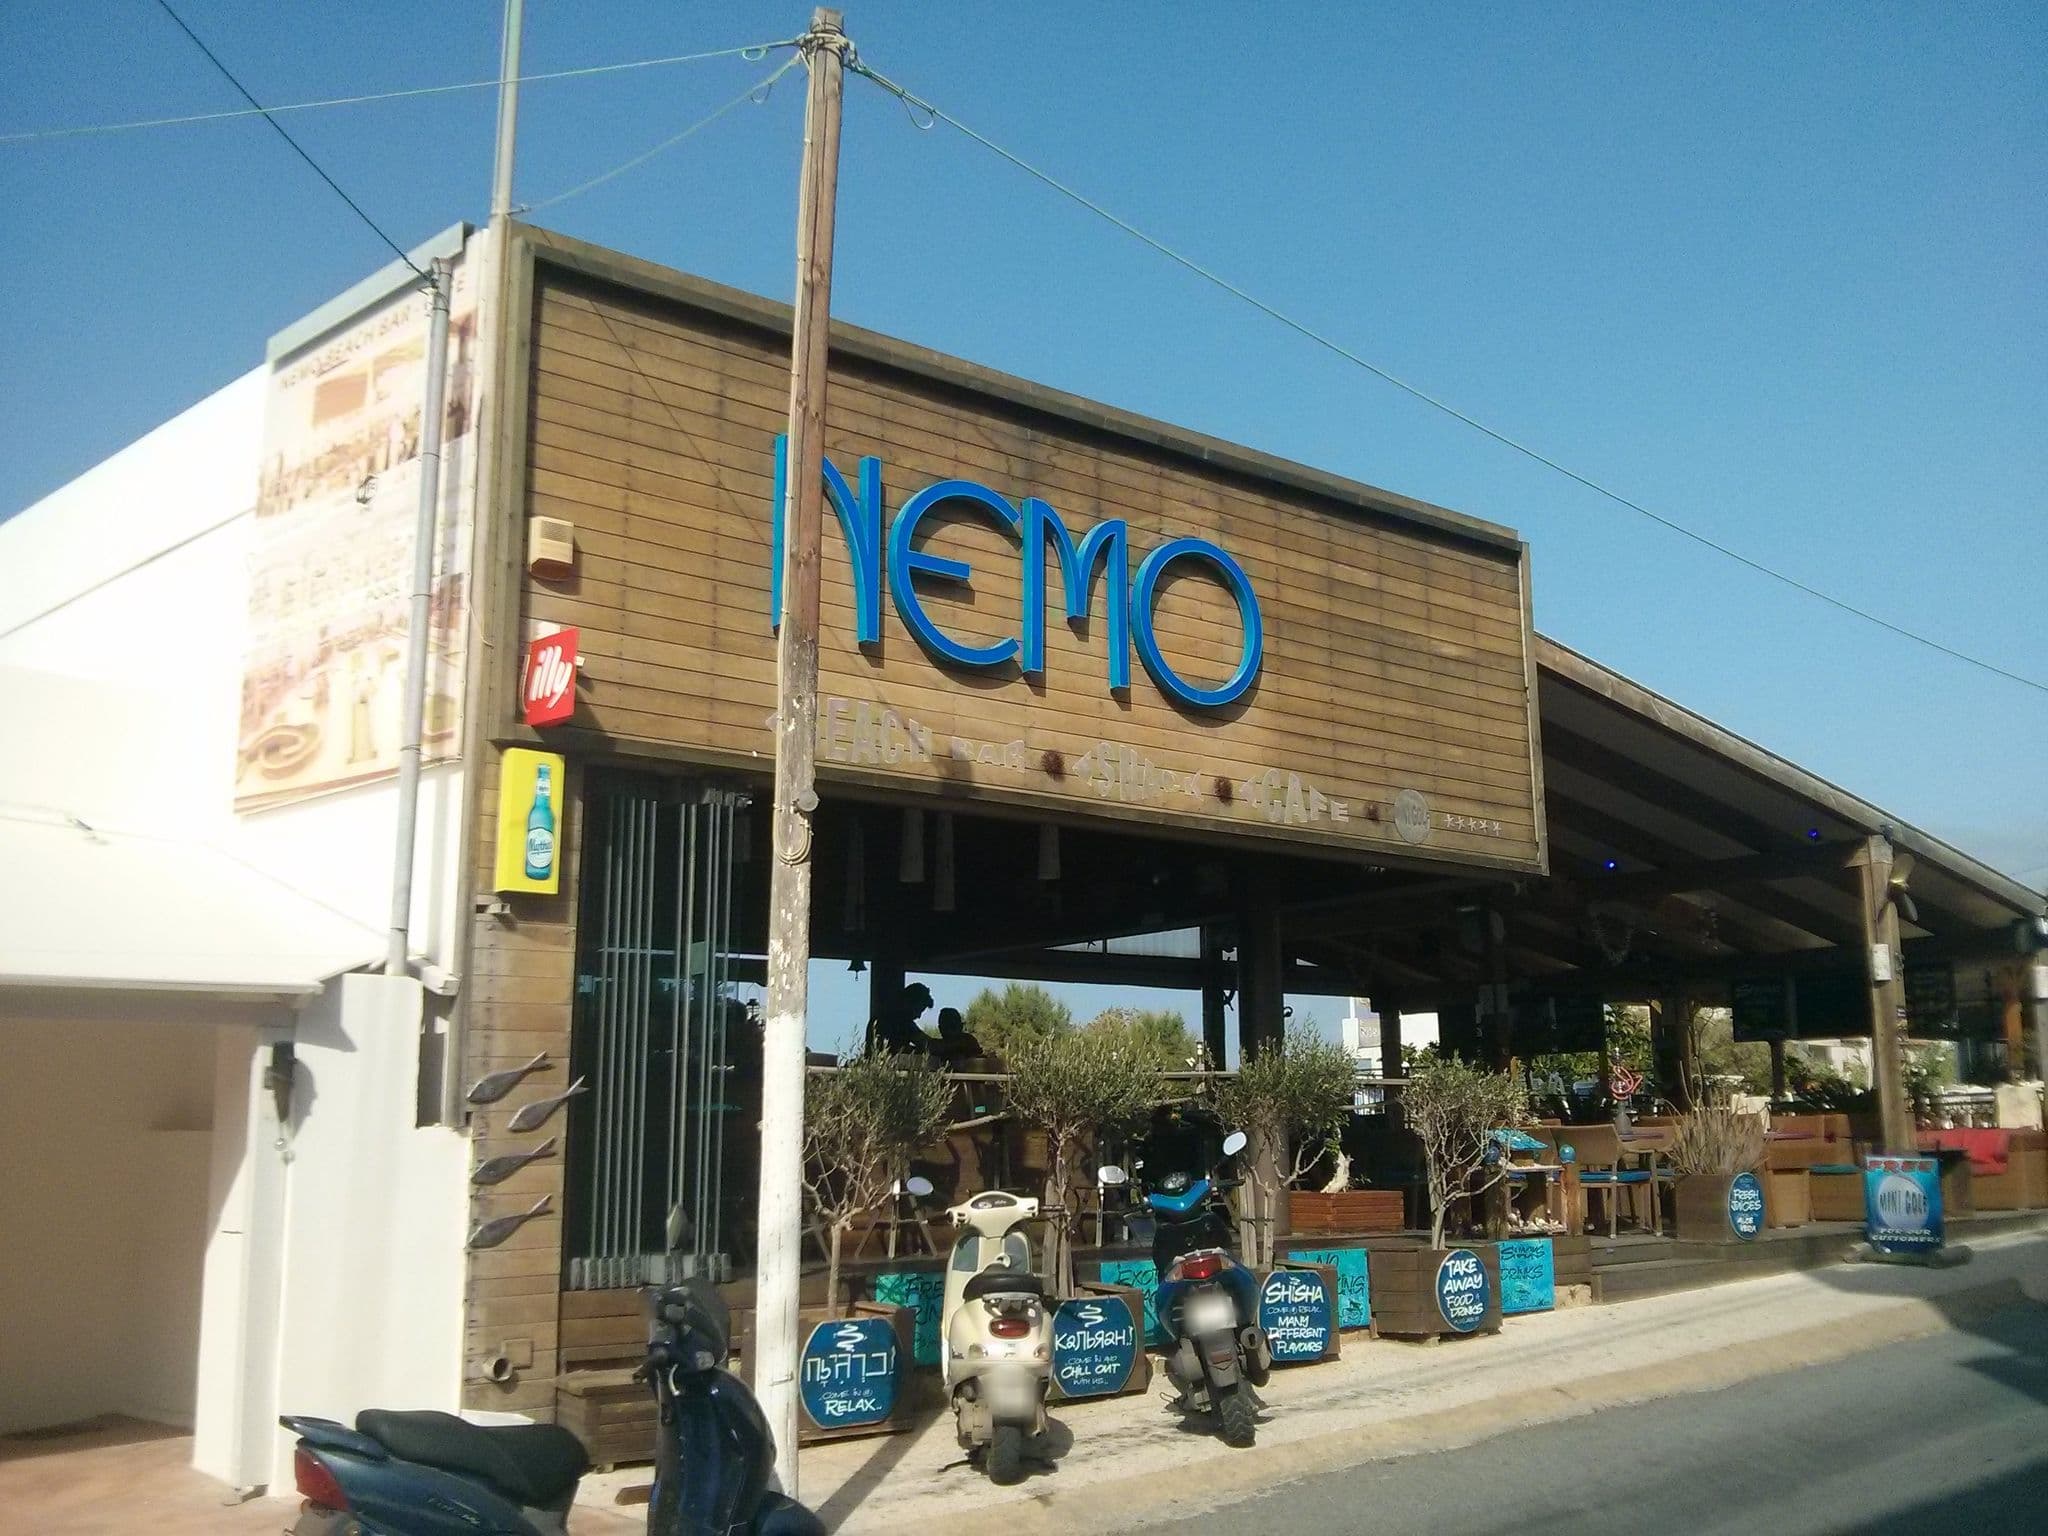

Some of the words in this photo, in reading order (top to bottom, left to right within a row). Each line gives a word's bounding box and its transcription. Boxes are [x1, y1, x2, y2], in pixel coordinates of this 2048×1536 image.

[380, 304, 411, 336] BAR
[773, 435, 1263, 706] NEMO
[529, 646, 573, 709] illy
[824, 697, 934, 765] EACH
[951, 736, 1027, 774] BAR
[1866, 1160, 1935, 1174] FREE
[1880, 1190, 1902, 1215] MINI
[1905, 1190, 1929, 1215] GOLF
[1871, 1234, 1942, 1243] CUSTOMERS
[1445, 1258, 1478, 1278] TAKE
[1443, 1273, 1483, 1294] AWAY
[1445, 1294, 1473, 1308] FOOD
[1450, 1303, 1484, 1317] DRINKS
[1278, 1315, 1309, 1328] MANY
[1267, 1326, 1326, 1340] DIFFERENT
[1094, 1363, 1120, 1374] OUT
